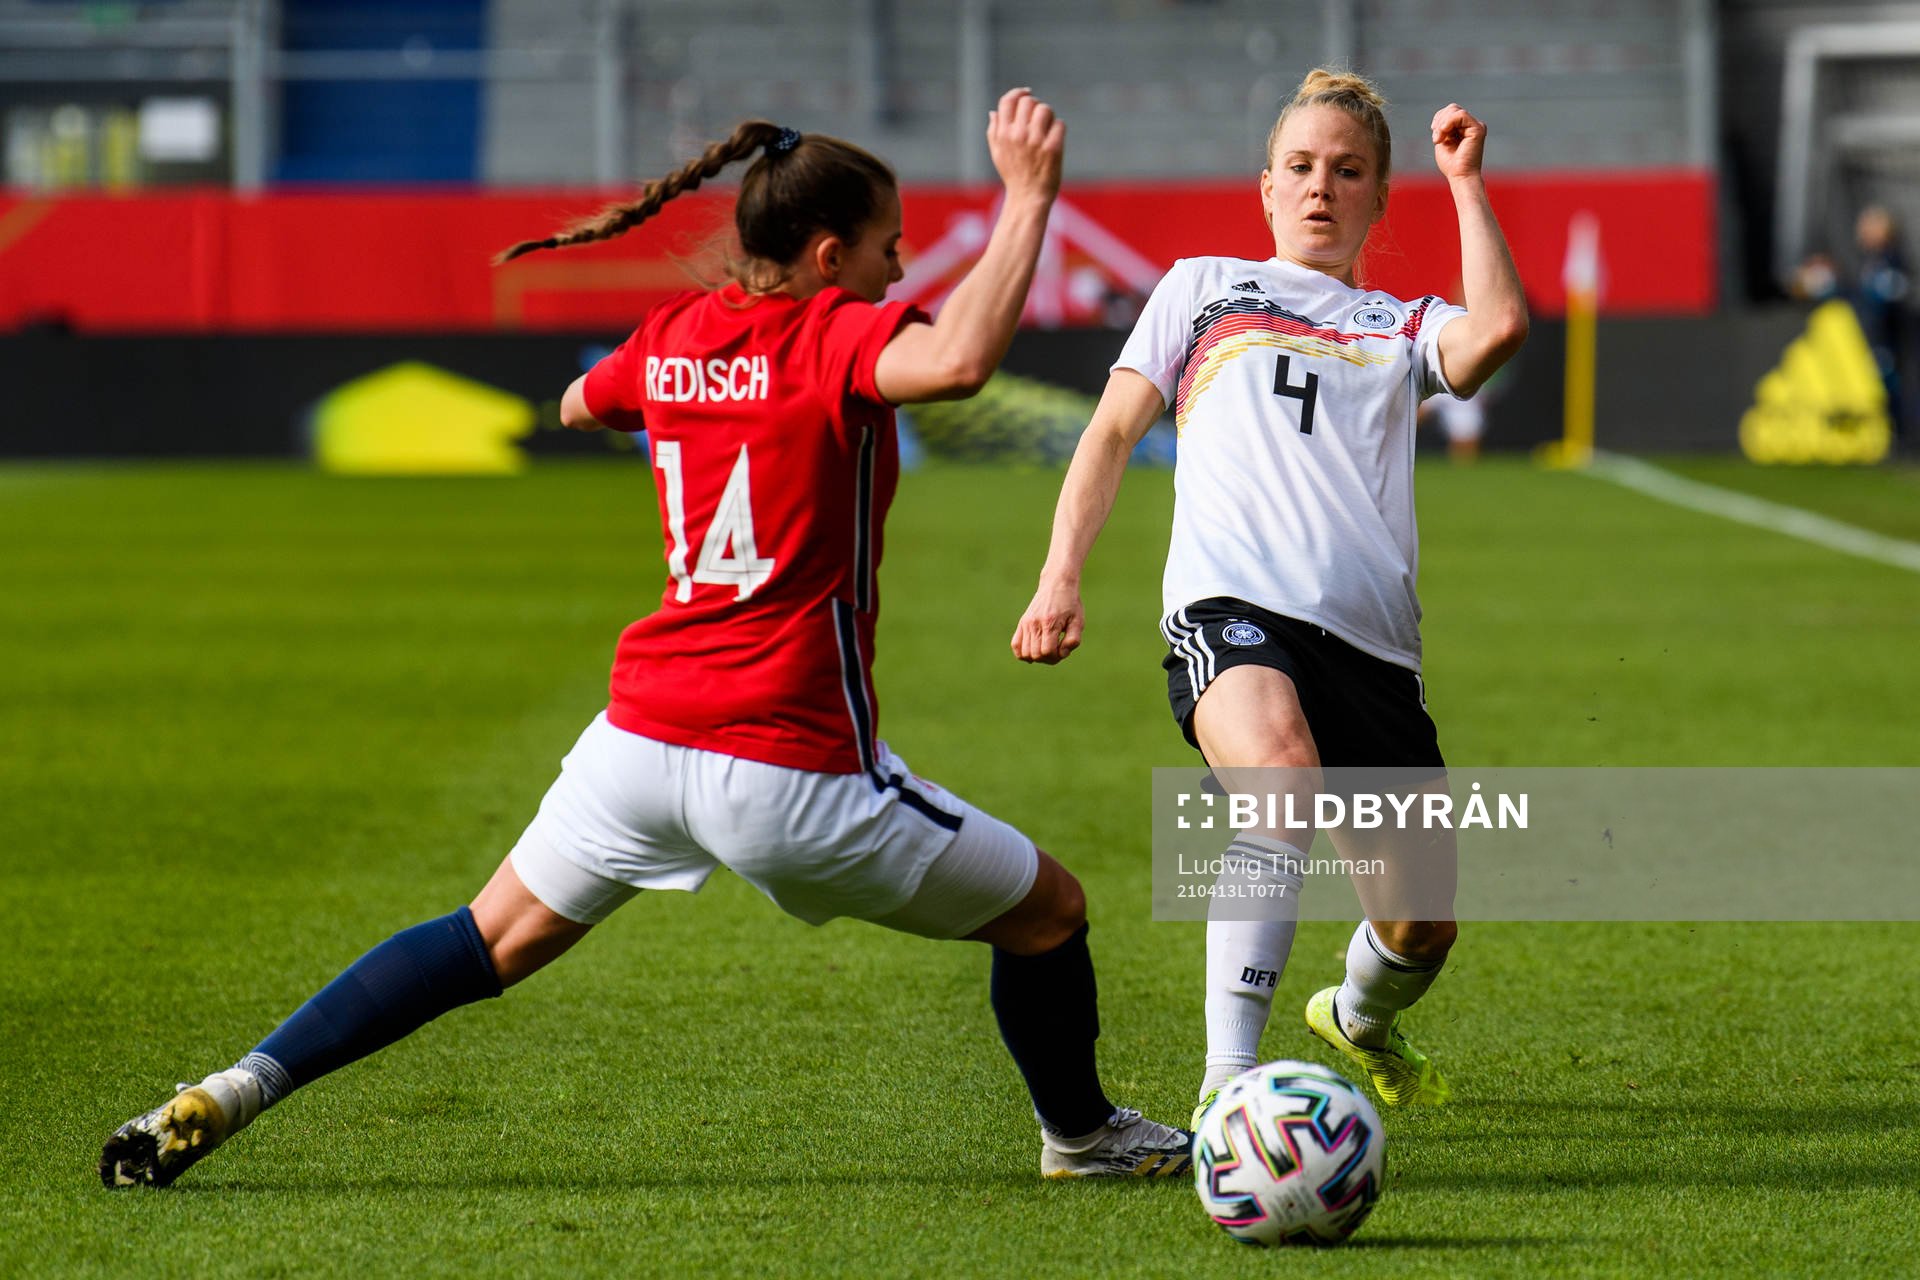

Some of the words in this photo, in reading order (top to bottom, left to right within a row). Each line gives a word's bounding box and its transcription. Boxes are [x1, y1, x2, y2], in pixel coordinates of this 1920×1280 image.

[646, 355, 768, 402] REDISCH
[1273, 354, 1318, 435] 4
[656, 440, 776, 603] 14
[1240, 966, 1278, 988] DFB
